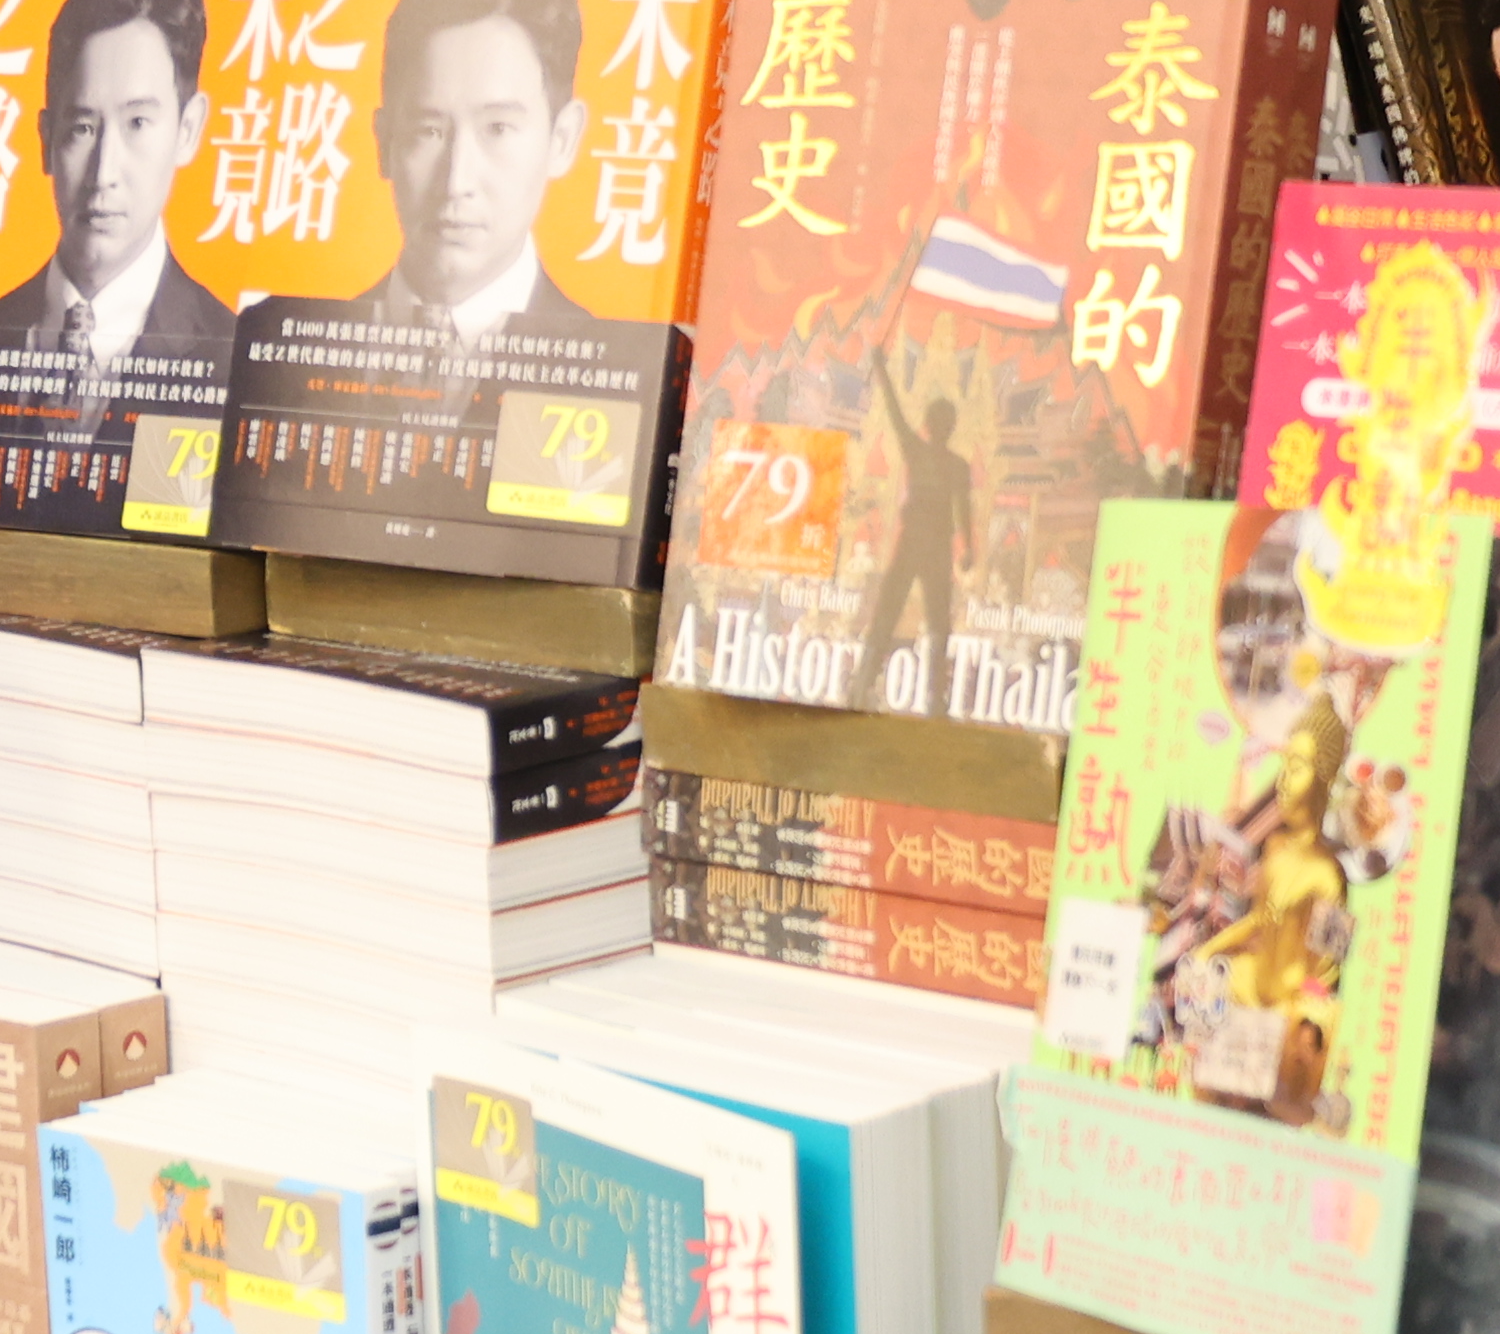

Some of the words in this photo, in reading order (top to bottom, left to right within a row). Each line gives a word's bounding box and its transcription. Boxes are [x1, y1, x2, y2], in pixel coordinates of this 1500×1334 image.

[1071, 0, 1220, 389] 泰國的
[1214, 95, 1285, 405] 泰國的歷史
[166, 427, 221, 479] 79
[539, 404, 610, 463] 79
[720, 448, 813, 527] 79
[780, 578, 818, 610] Chris
[821, 584, 861, 615] Baker
[668, 611, 700, 688] A
[885, 633, 932, 715] of
[698, 776, 774, 823] Thailand
[705, 865, 778, 912] Thailand
[465, 1091, 518, 1156] 79
[49, 1144, 76, 1265] 柿崎一郎
[255, 1196, 319, 1259] 79
